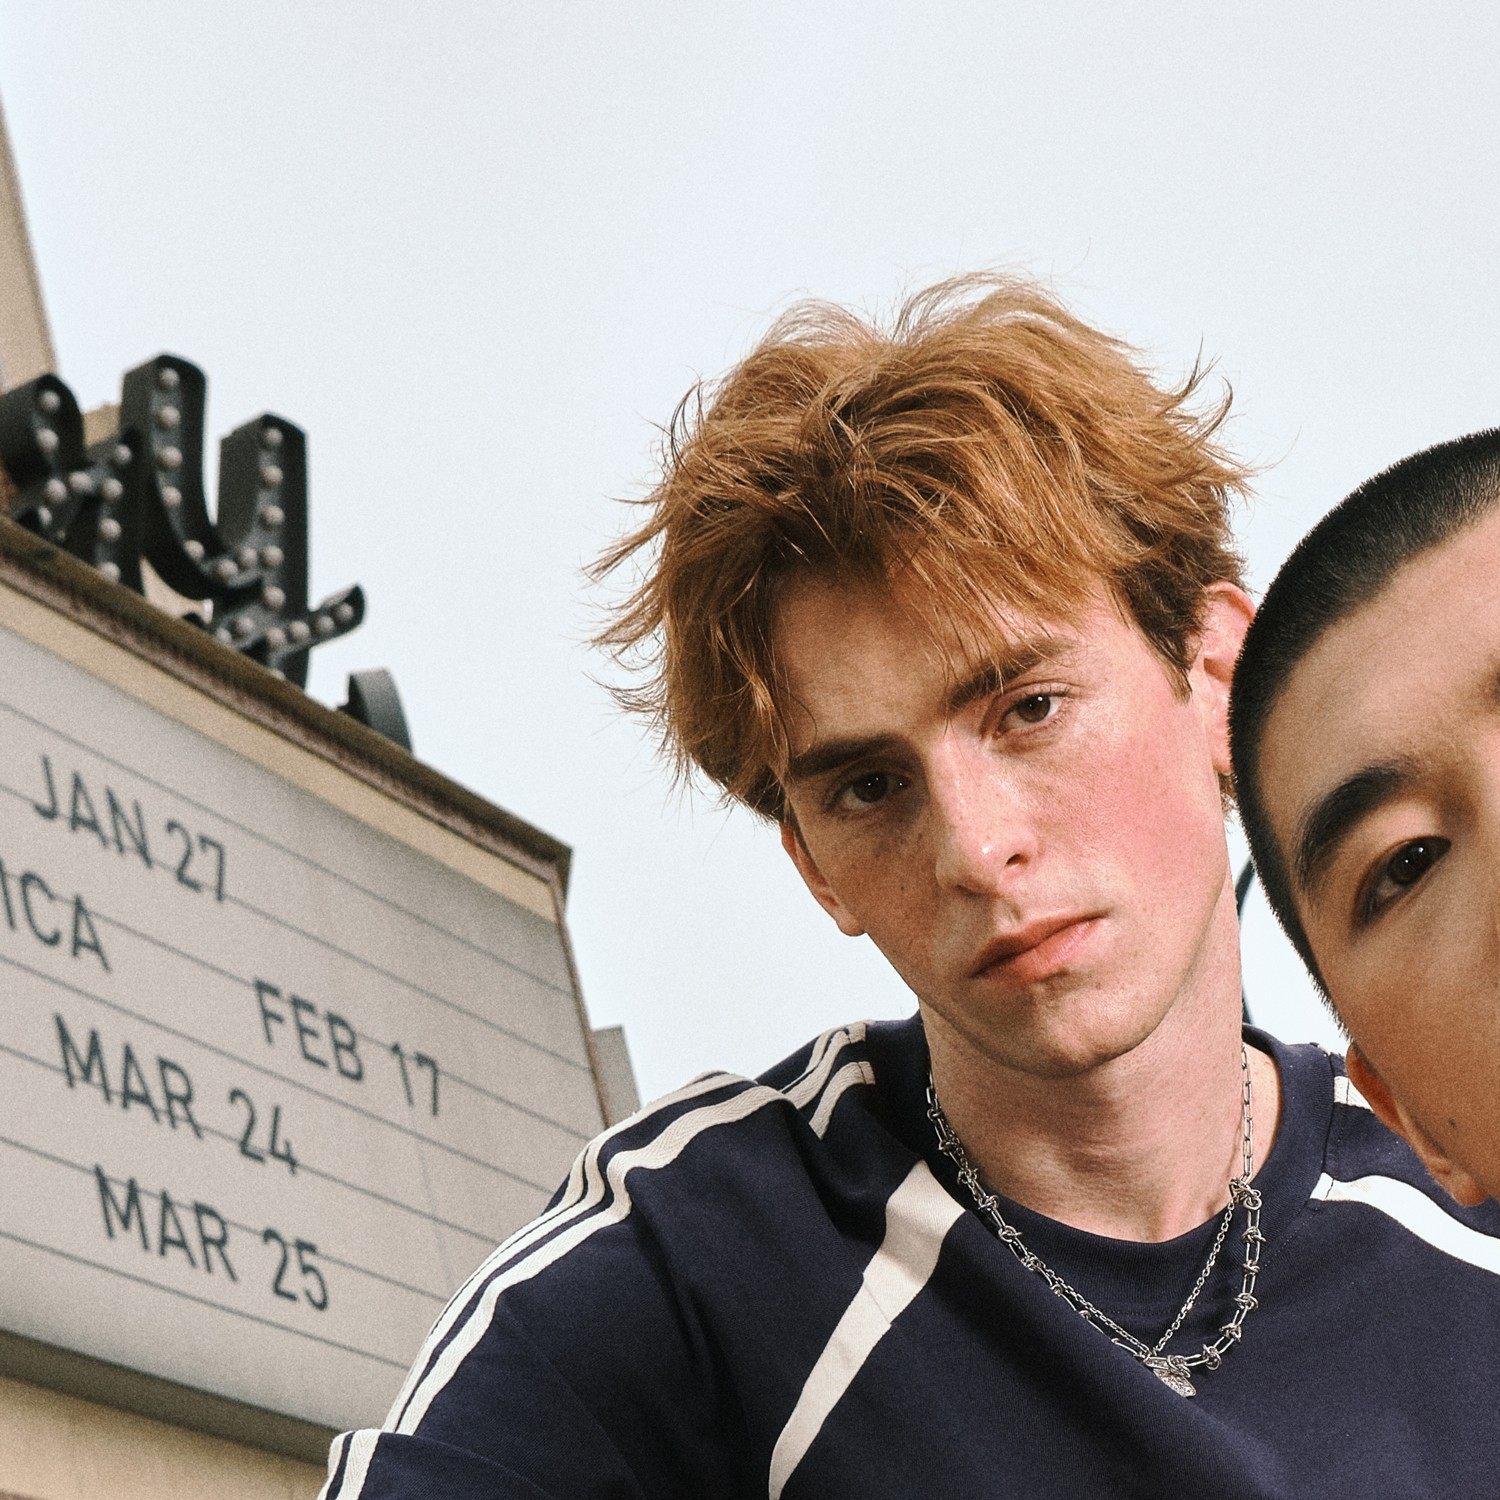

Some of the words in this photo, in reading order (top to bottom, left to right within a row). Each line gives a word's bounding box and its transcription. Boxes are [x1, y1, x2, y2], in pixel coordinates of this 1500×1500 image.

[33, 755, 153, 869] JAN
[165, 820, 226, 902] 27
[53, 1012, 203, 1140] MAR
[228, 1088, 299, 1175] 24
[253, 978, 365, 1083] FEB
[389, 1041, 441, 1116] 17
[94, 1163, 239, 1282] MAR
[261, 1227, 329, 1312] 25
